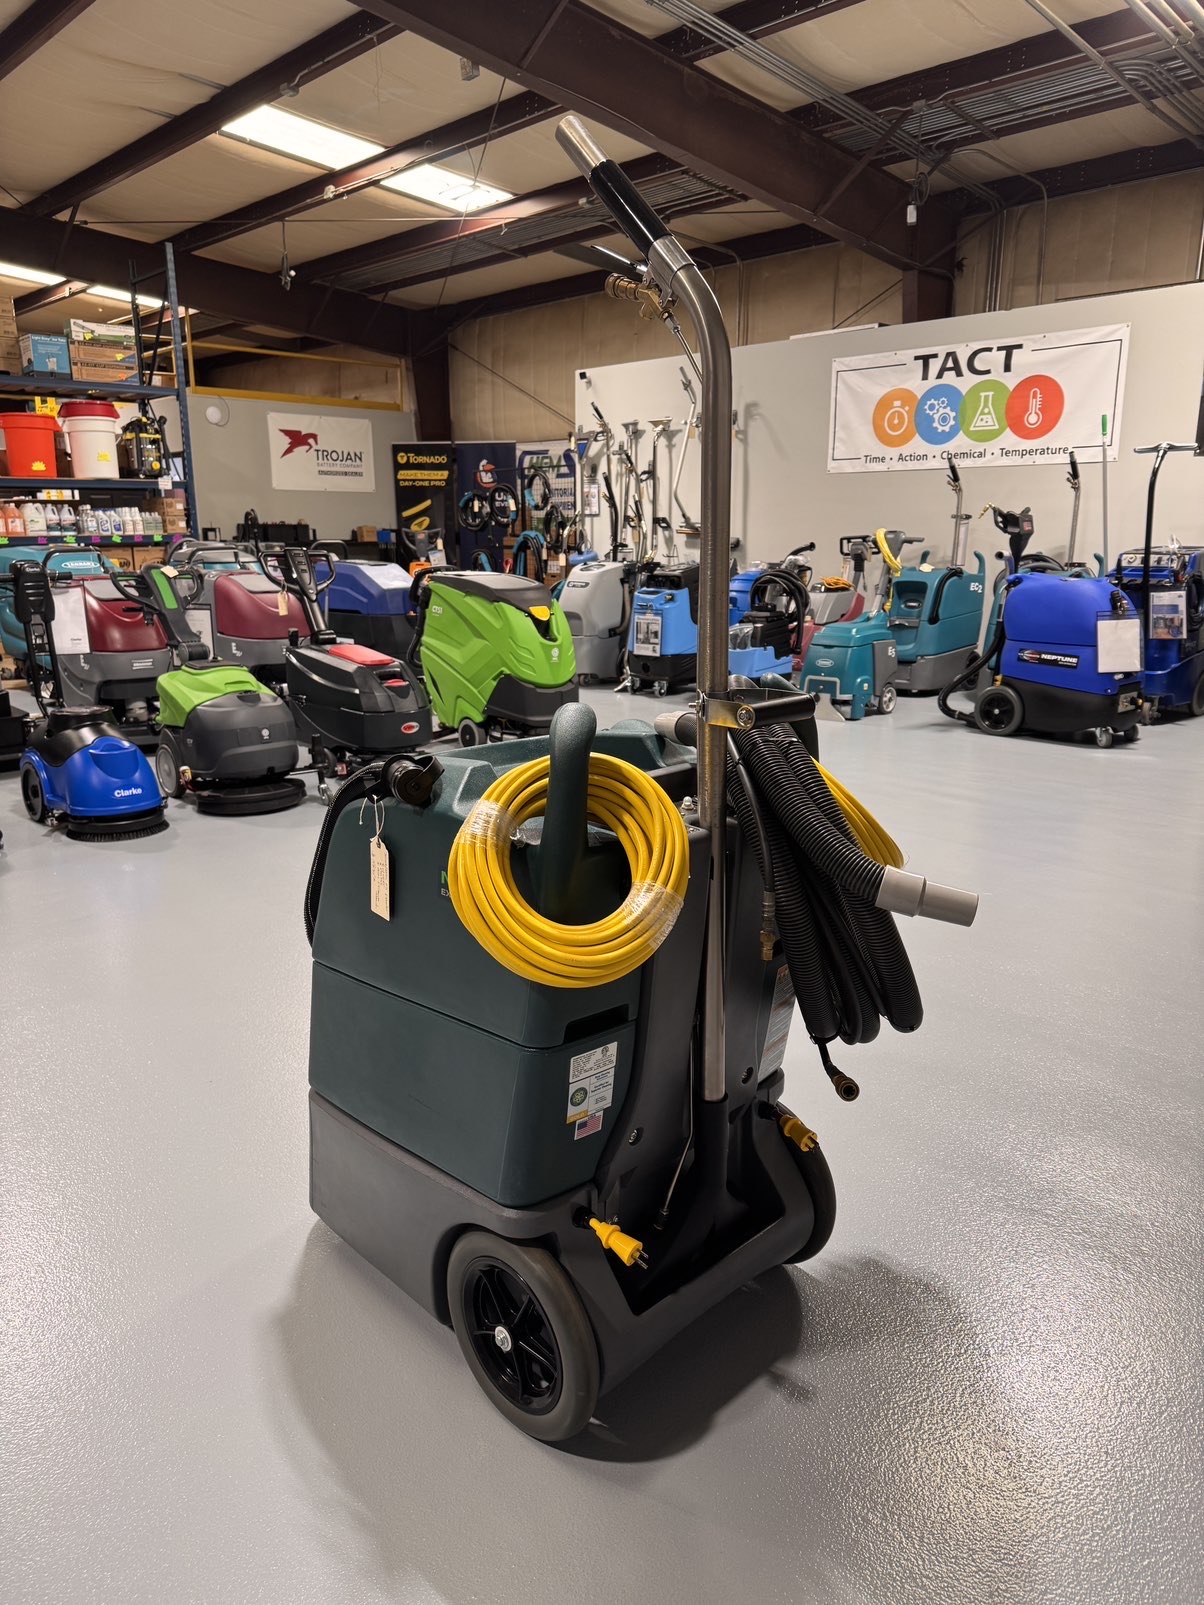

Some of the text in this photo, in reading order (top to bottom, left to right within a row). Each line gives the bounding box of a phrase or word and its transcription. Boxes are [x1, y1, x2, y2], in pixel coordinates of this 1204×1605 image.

[914, 344, 1023, 381] TACT
[314, 449, 362, 462] TROJAN
[408, 453, 447, 464] TORNADO
[864, 446, 1069, 464] Time Action Chemical Temperature
[1040, 653, 1078, 663] NEPTUNE
[114, 787, 143, 798] Clarke
